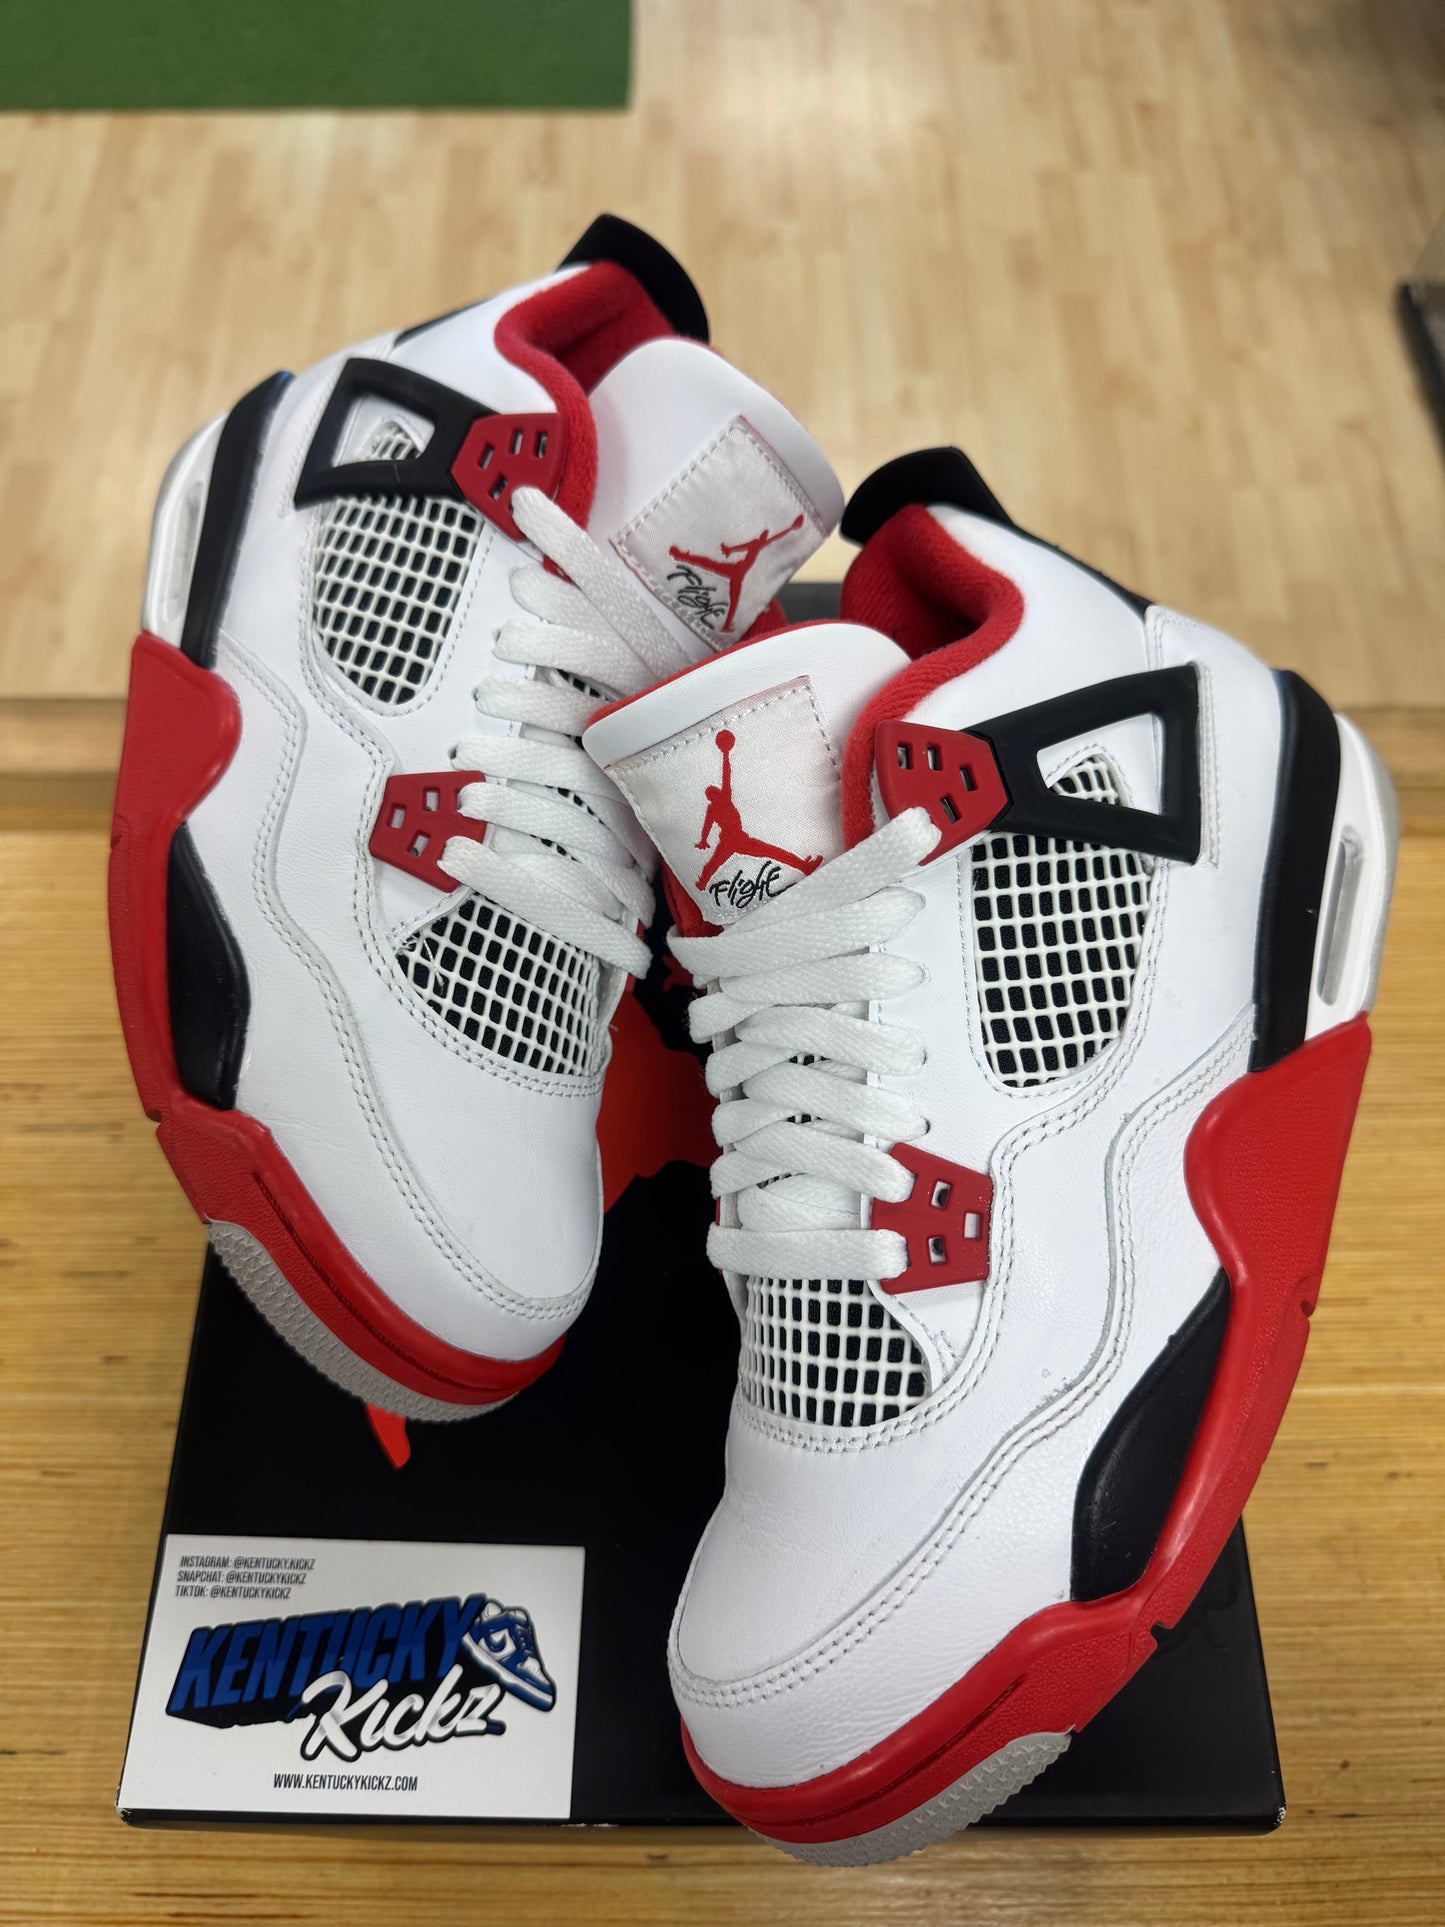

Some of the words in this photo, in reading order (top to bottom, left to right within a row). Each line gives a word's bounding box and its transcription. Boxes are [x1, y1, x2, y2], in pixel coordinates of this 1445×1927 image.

[709, 861, 797, 908] Flight
[180, 1556, 232, 1568] INSTAGRAM:
[178, 1570, 225, 1582] SNAPCHAT:
[226, 1570, 307, 1584] @KENTUCKYKICKZ
[175, 1585, 209, 1597] TIKTOK:
[210, 1585, 292, 1599] @KENTUCKYKICKZ
[169, 1594, 487, 1713] KENTUCKY
[302, 1663, 501, 1759] Kickz
[273, 1773, 418, 1791] WWW.KENTUCKYKICKZ.COM
